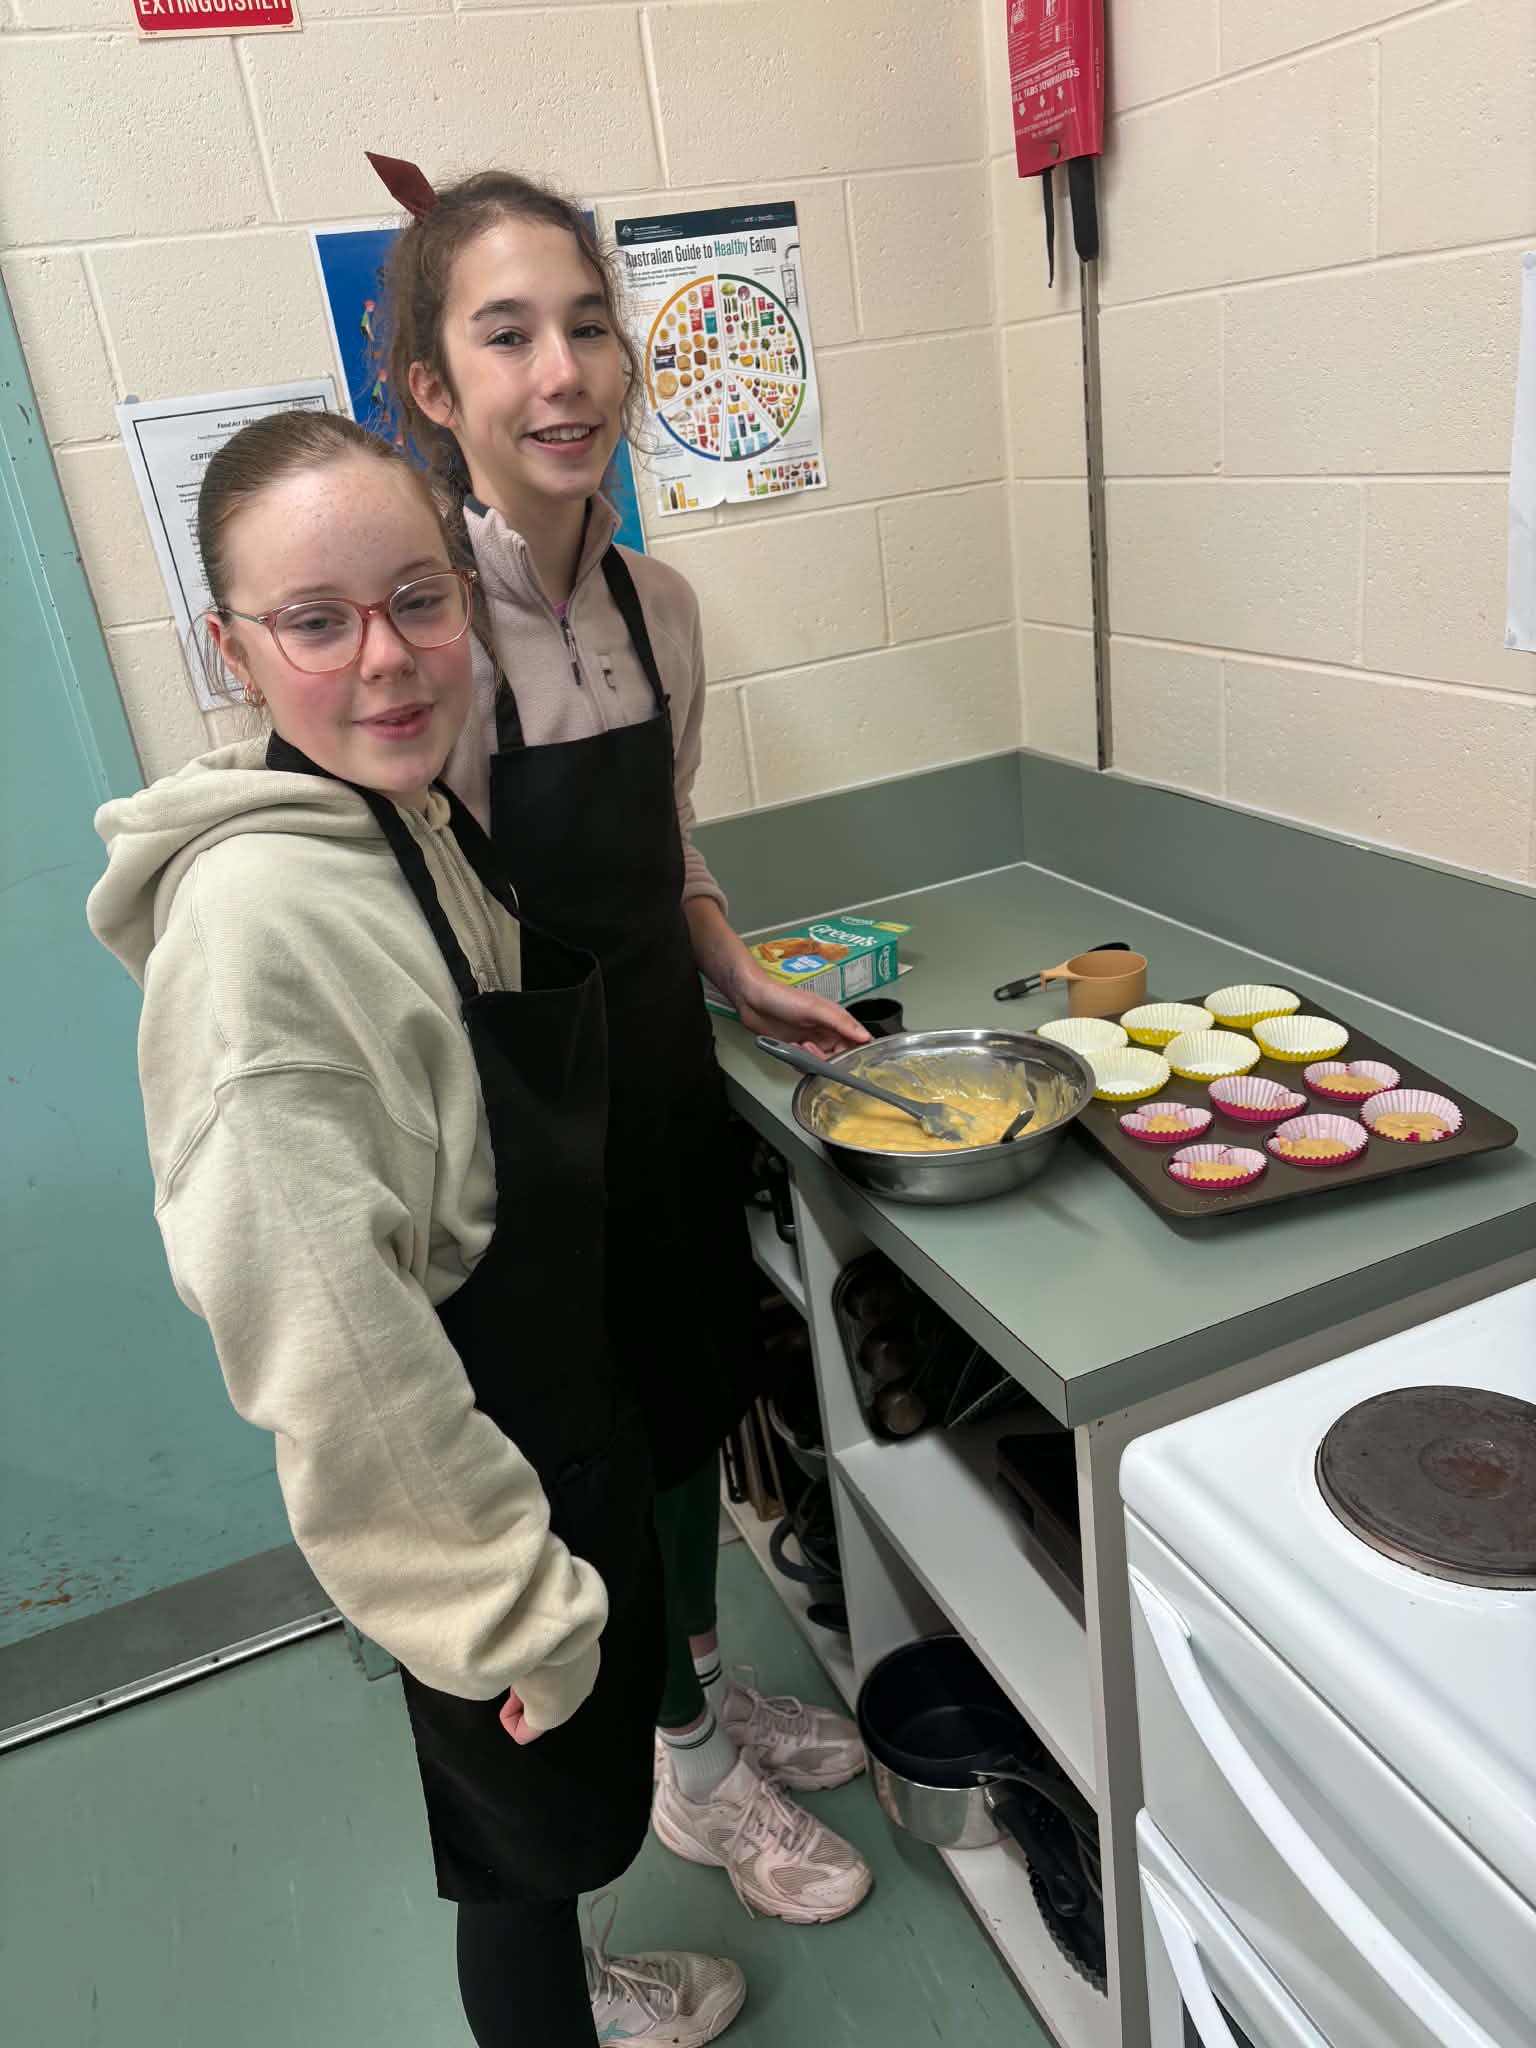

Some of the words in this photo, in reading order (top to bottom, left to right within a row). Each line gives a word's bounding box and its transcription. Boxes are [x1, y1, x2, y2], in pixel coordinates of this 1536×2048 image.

[625, 247, 674, 268] Australian
[675, 243, 702, 262] Guide
[703, 243, 713, 259] to
[714, 239, 748, 257] Healthy
[749, 235, 777, 254] Eating
[808, 924, 878, 947] Green's
